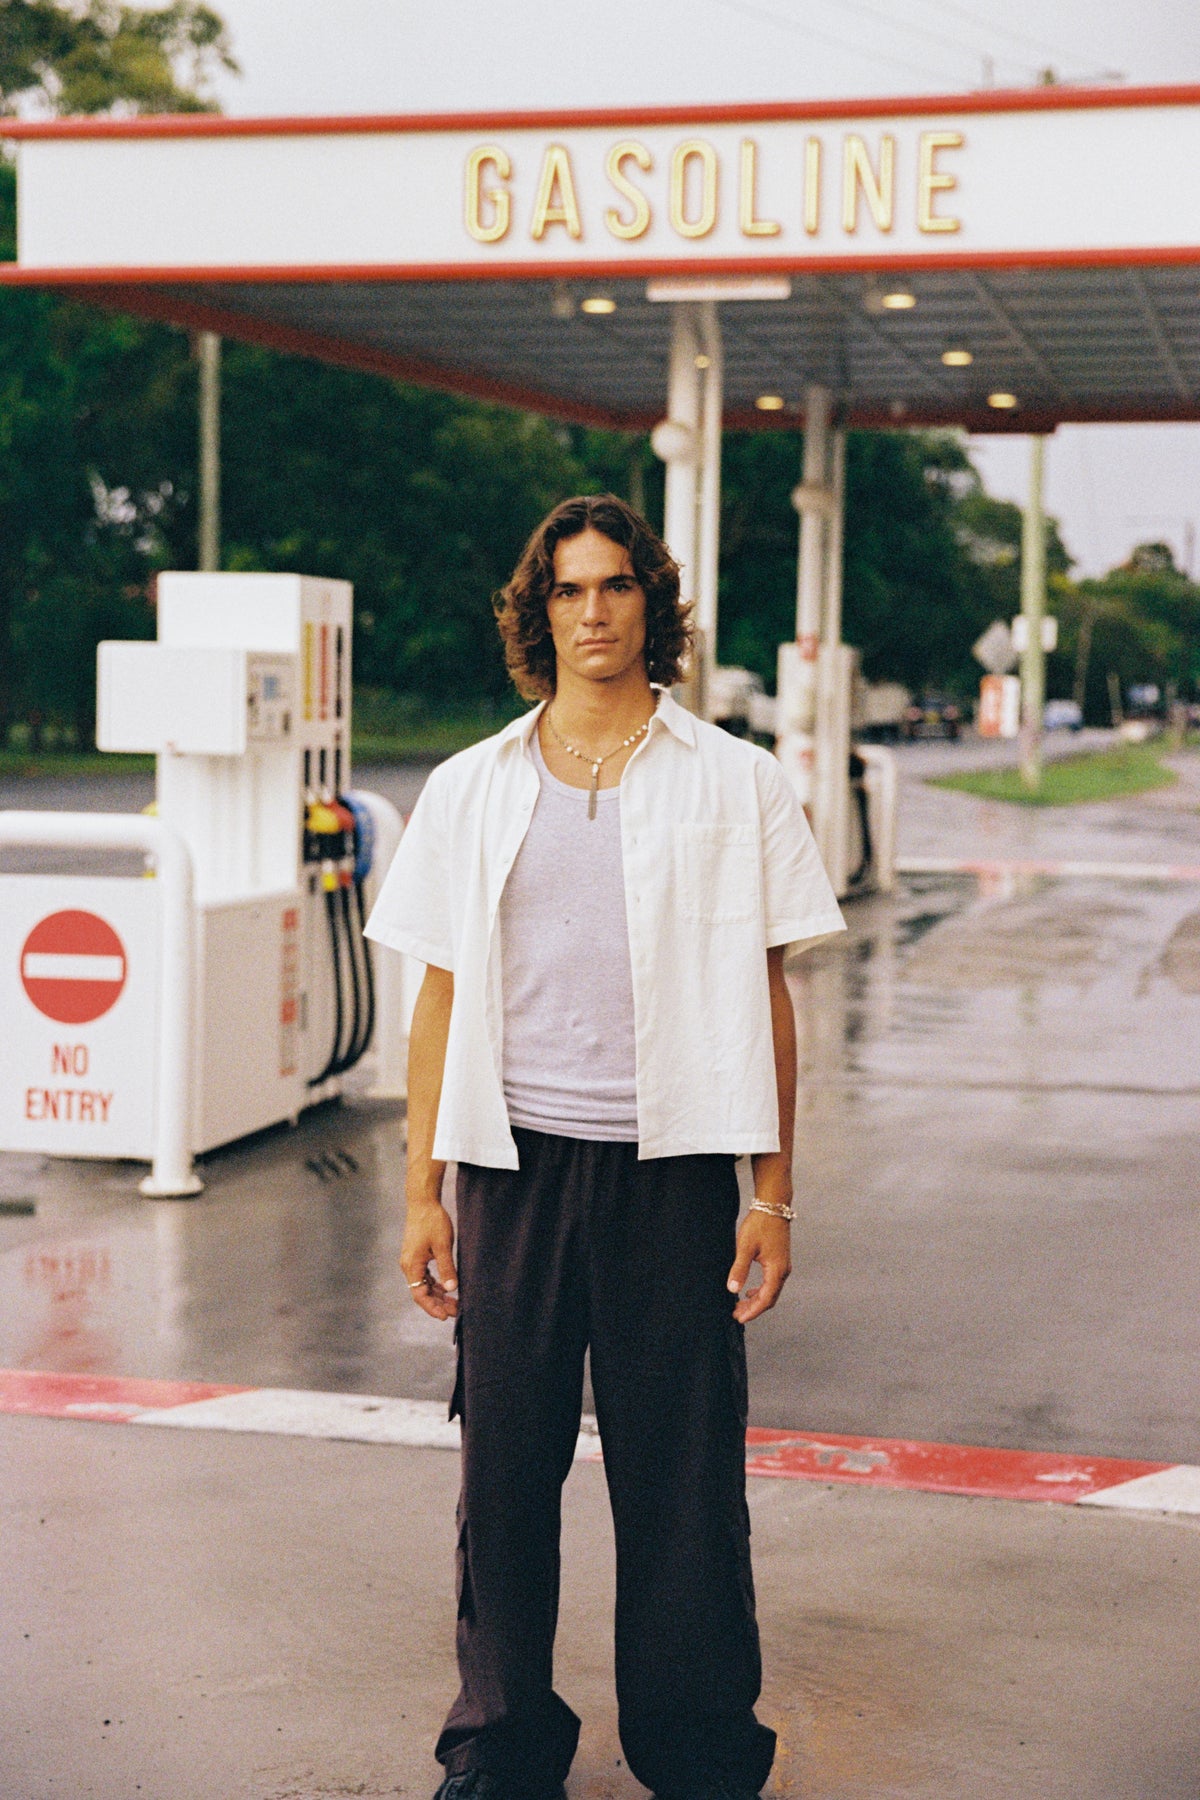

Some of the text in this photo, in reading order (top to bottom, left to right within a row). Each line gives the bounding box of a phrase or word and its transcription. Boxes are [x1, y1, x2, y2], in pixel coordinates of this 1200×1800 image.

[463, 131, 967, 244] GASOLINE
[51, 1042, 89, 1077] NO
[25, 1086, 114, 1123] ENTRY
